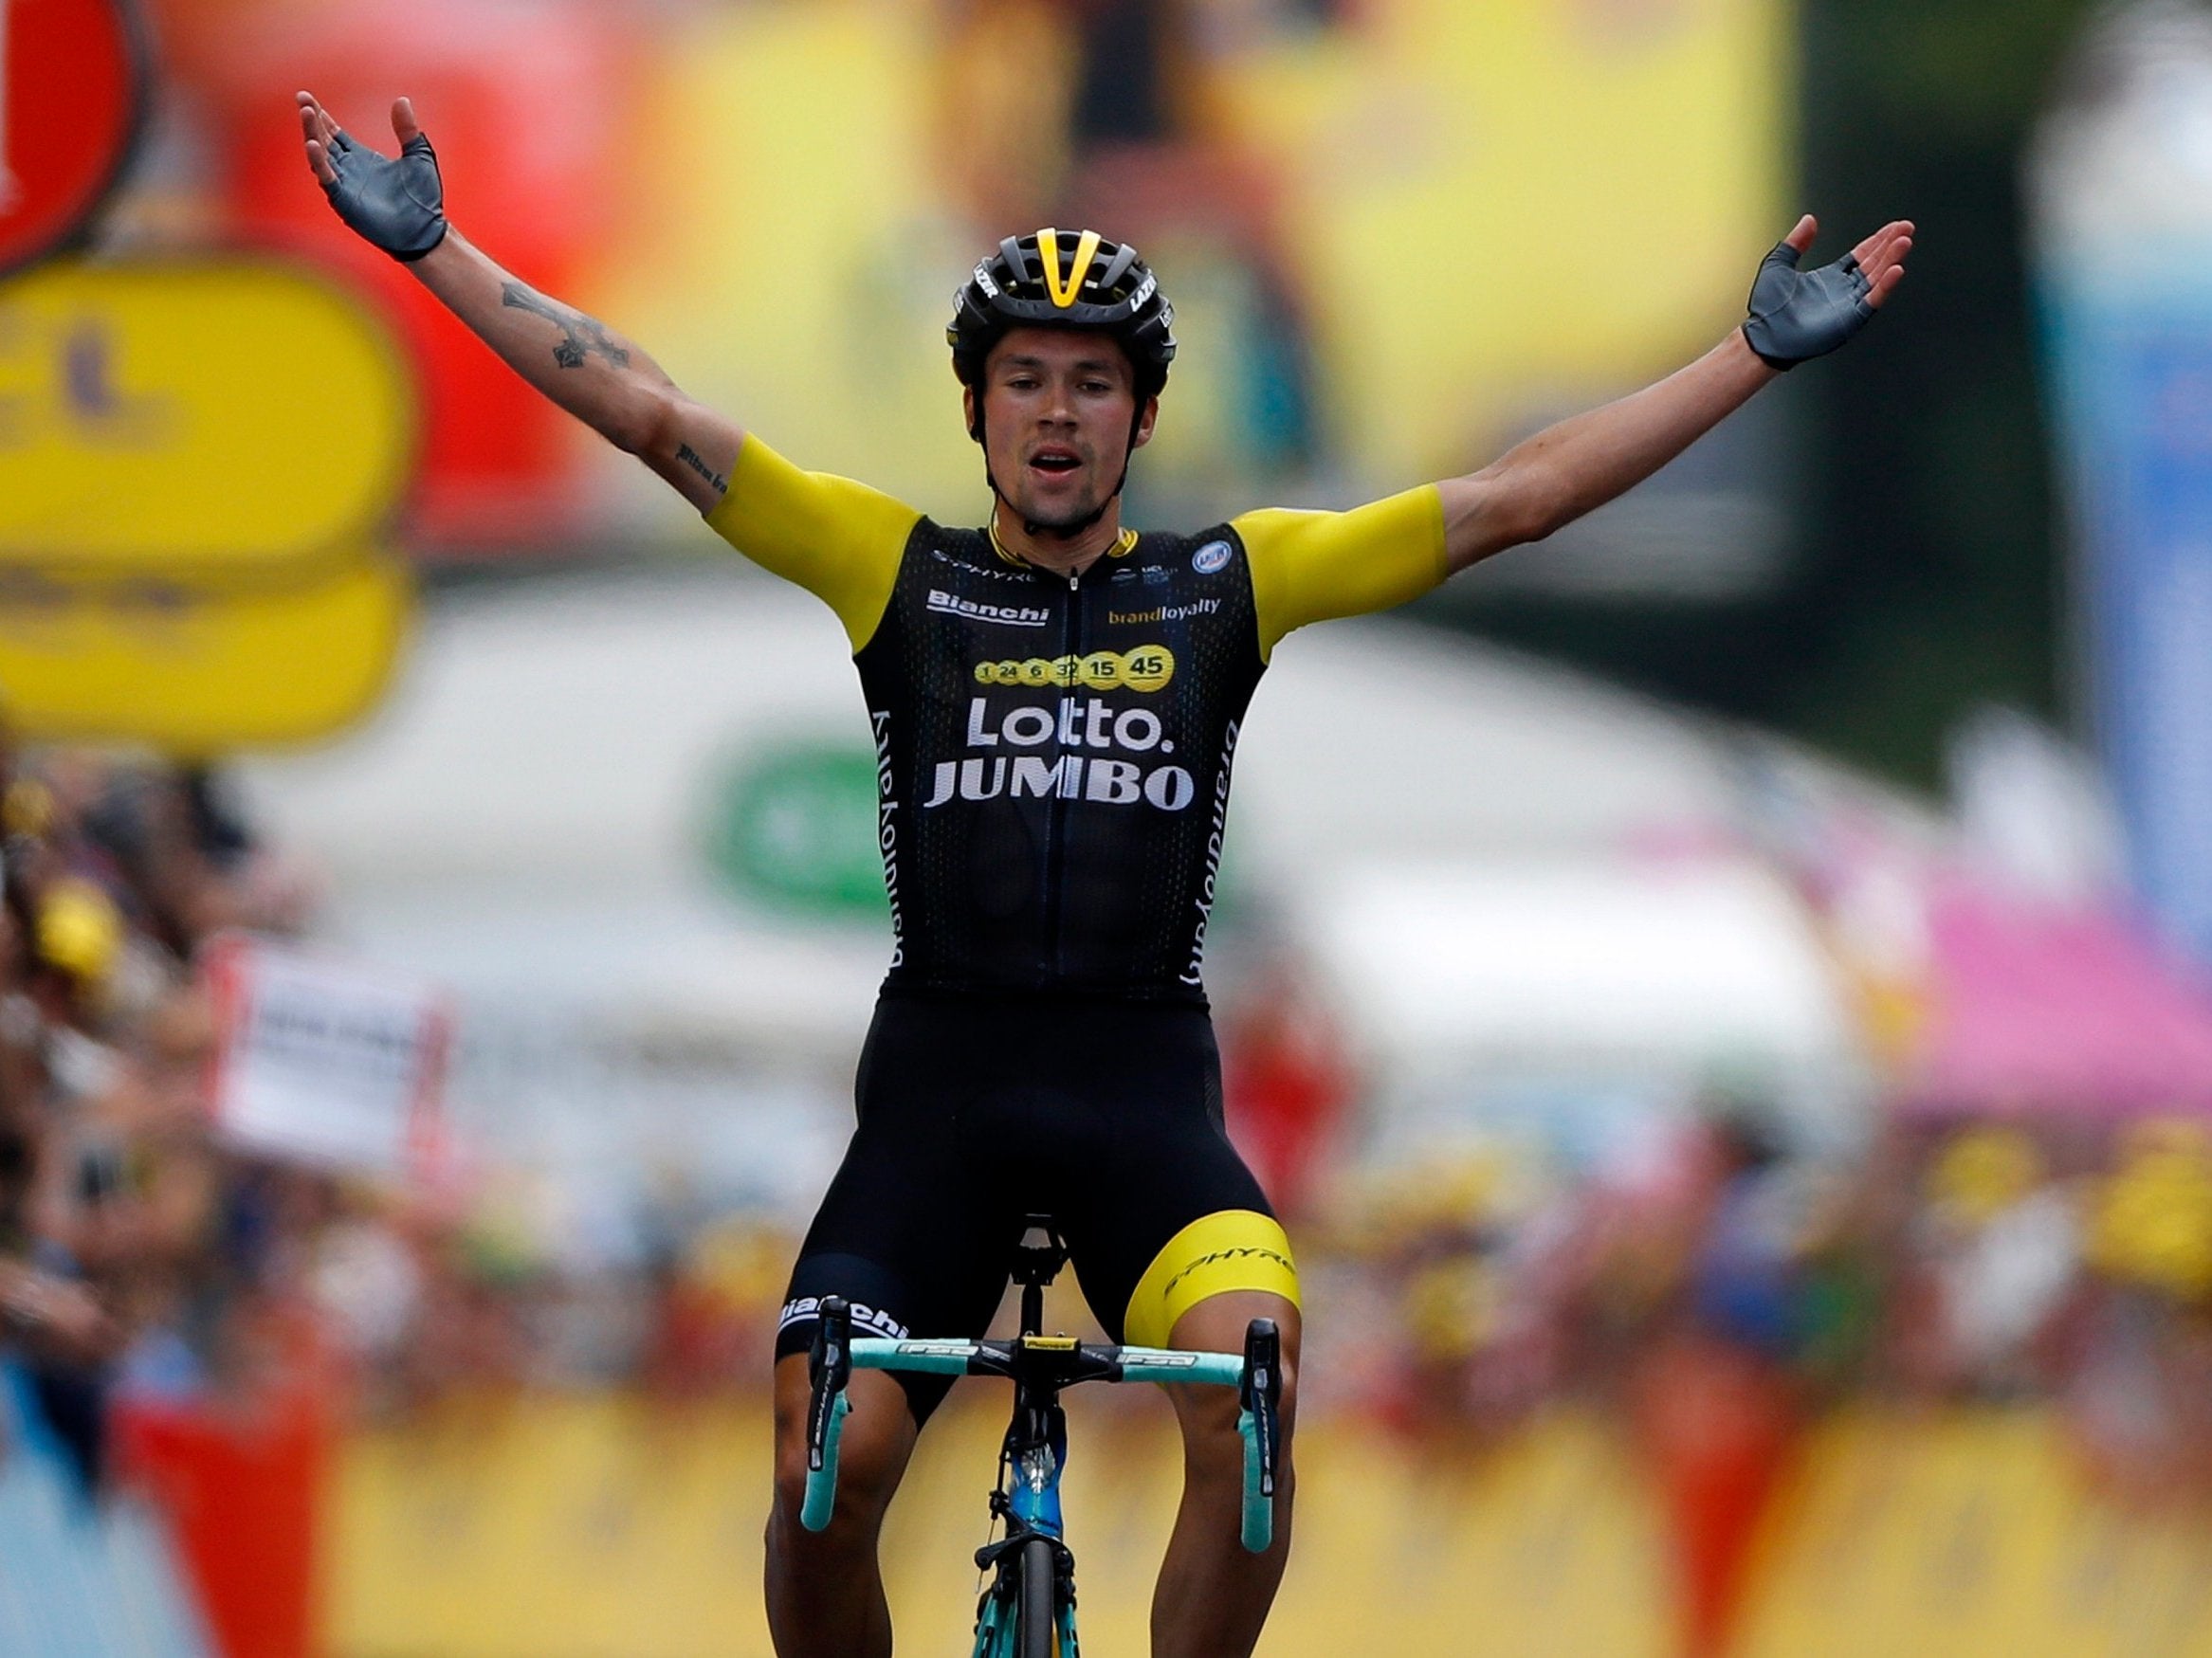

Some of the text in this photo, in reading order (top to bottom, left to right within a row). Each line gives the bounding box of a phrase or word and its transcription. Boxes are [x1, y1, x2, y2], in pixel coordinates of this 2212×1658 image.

[927, 589, 1050, 622] Bianchi
[1108, 598, 1222, 625] brandloyalty
[999, 665, 1017, 677] 24
[1031, 665, 1042, 677] 6
[1091, 661, 1115, 676] 15
[1128, 655, 1164, 675] 45
[966, 696, 1176, 754] Lotto.
[923, 753, 1197, 811] JUMBO
